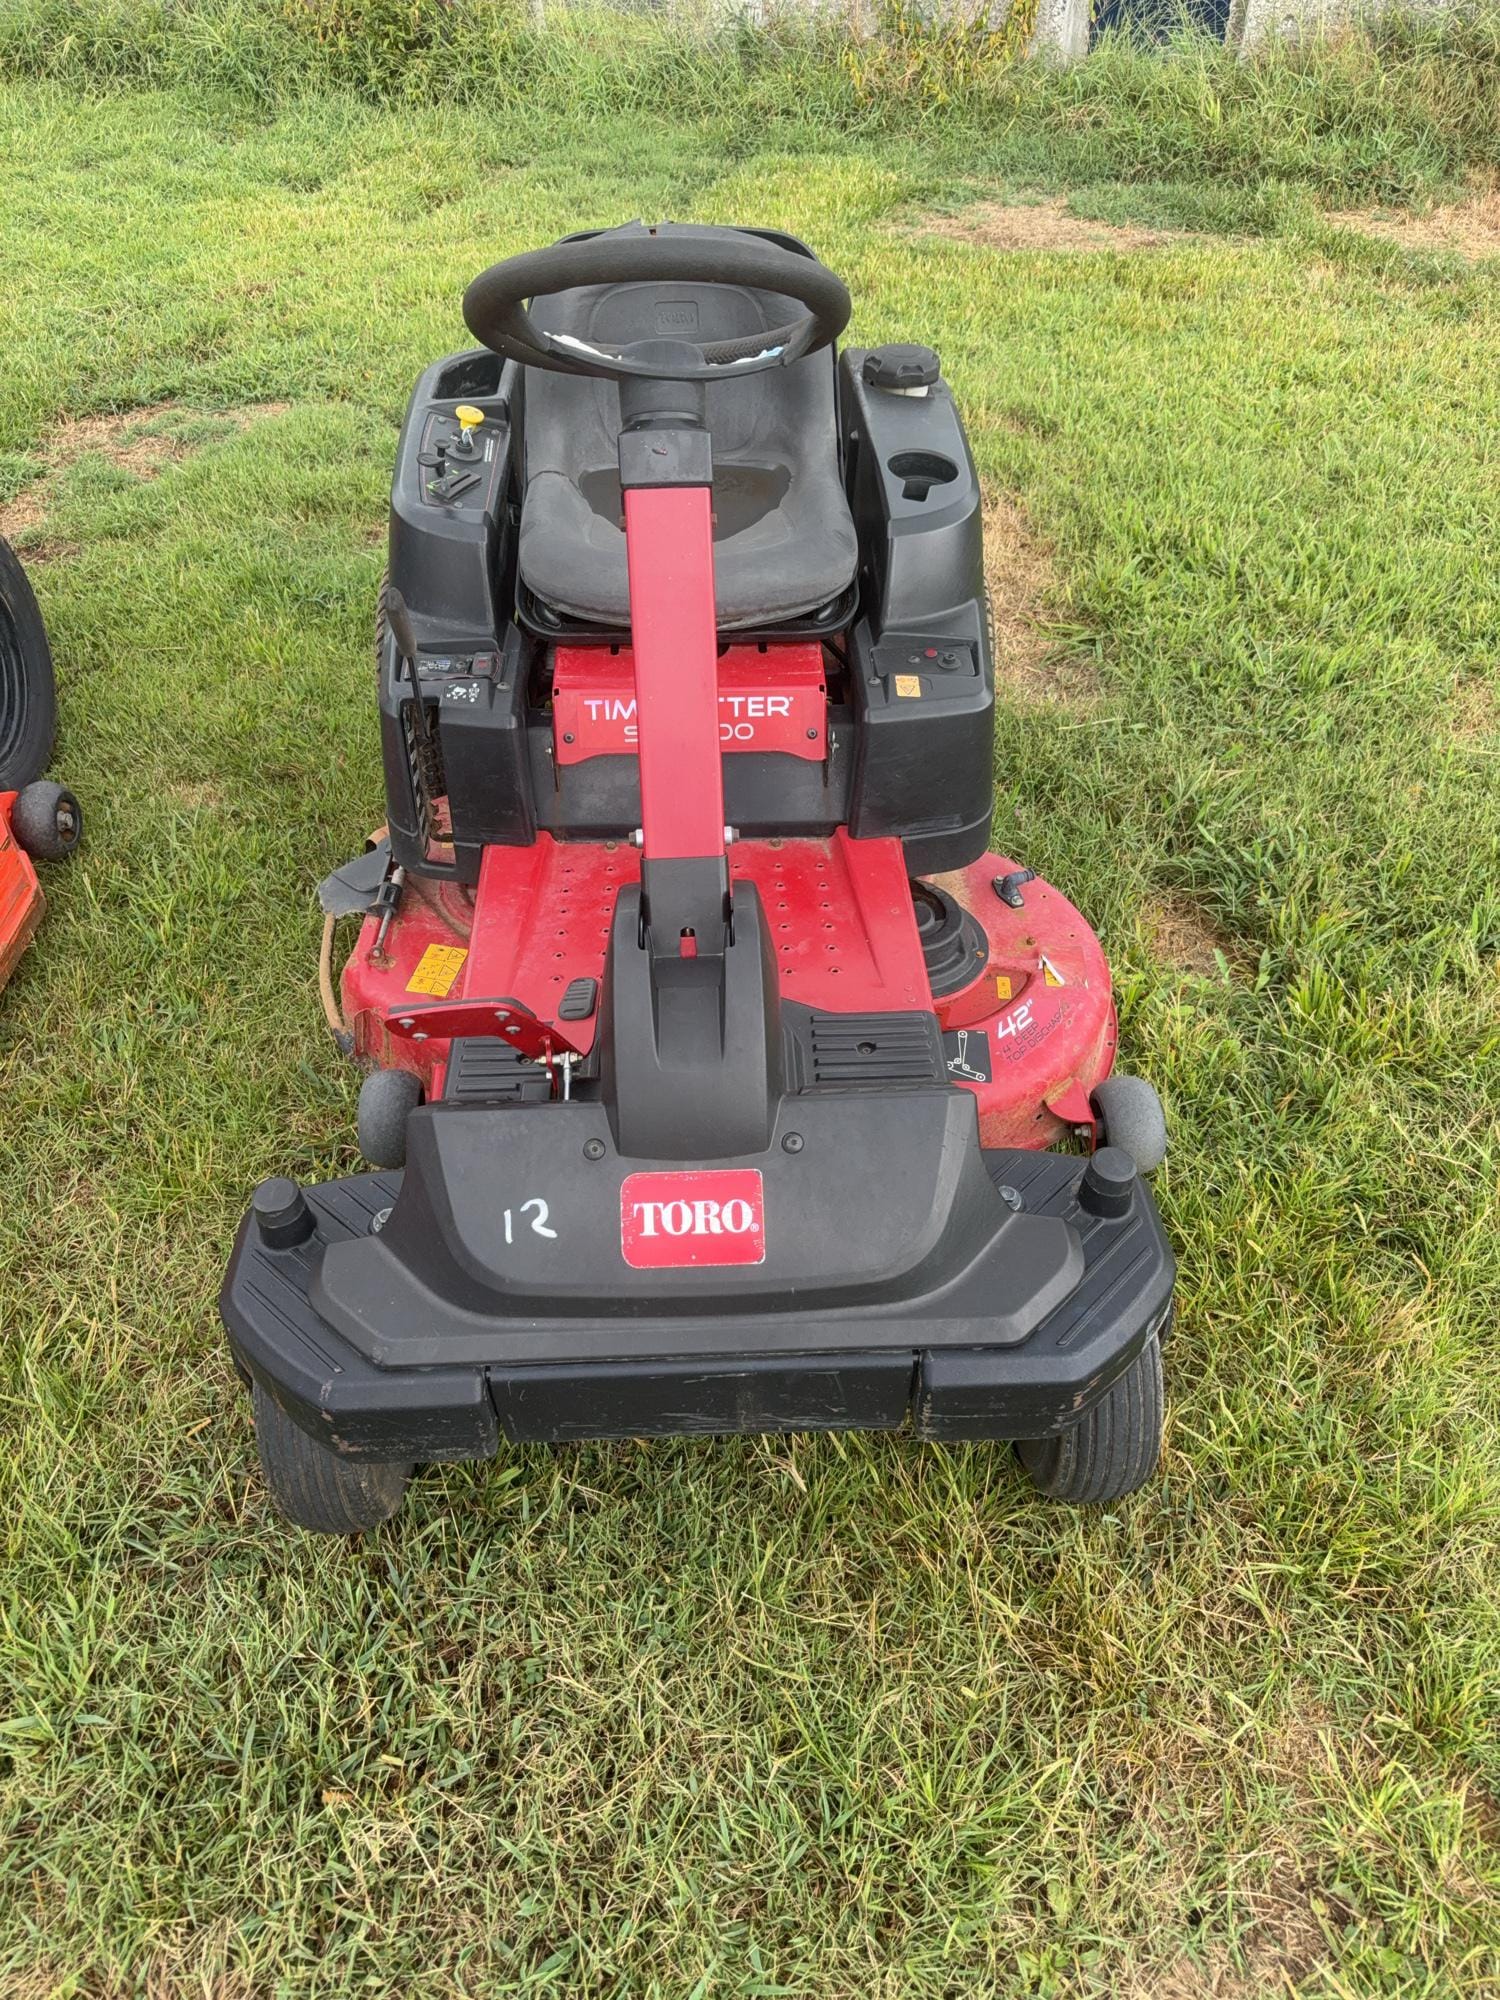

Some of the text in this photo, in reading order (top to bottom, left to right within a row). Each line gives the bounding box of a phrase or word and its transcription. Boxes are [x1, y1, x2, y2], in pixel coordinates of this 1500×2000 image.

[1014, 1021, 1039, 1046] DEEP
[1006, 1044, 1027, 1064] TOP
[633, 1199, 754, 1236] TORO
